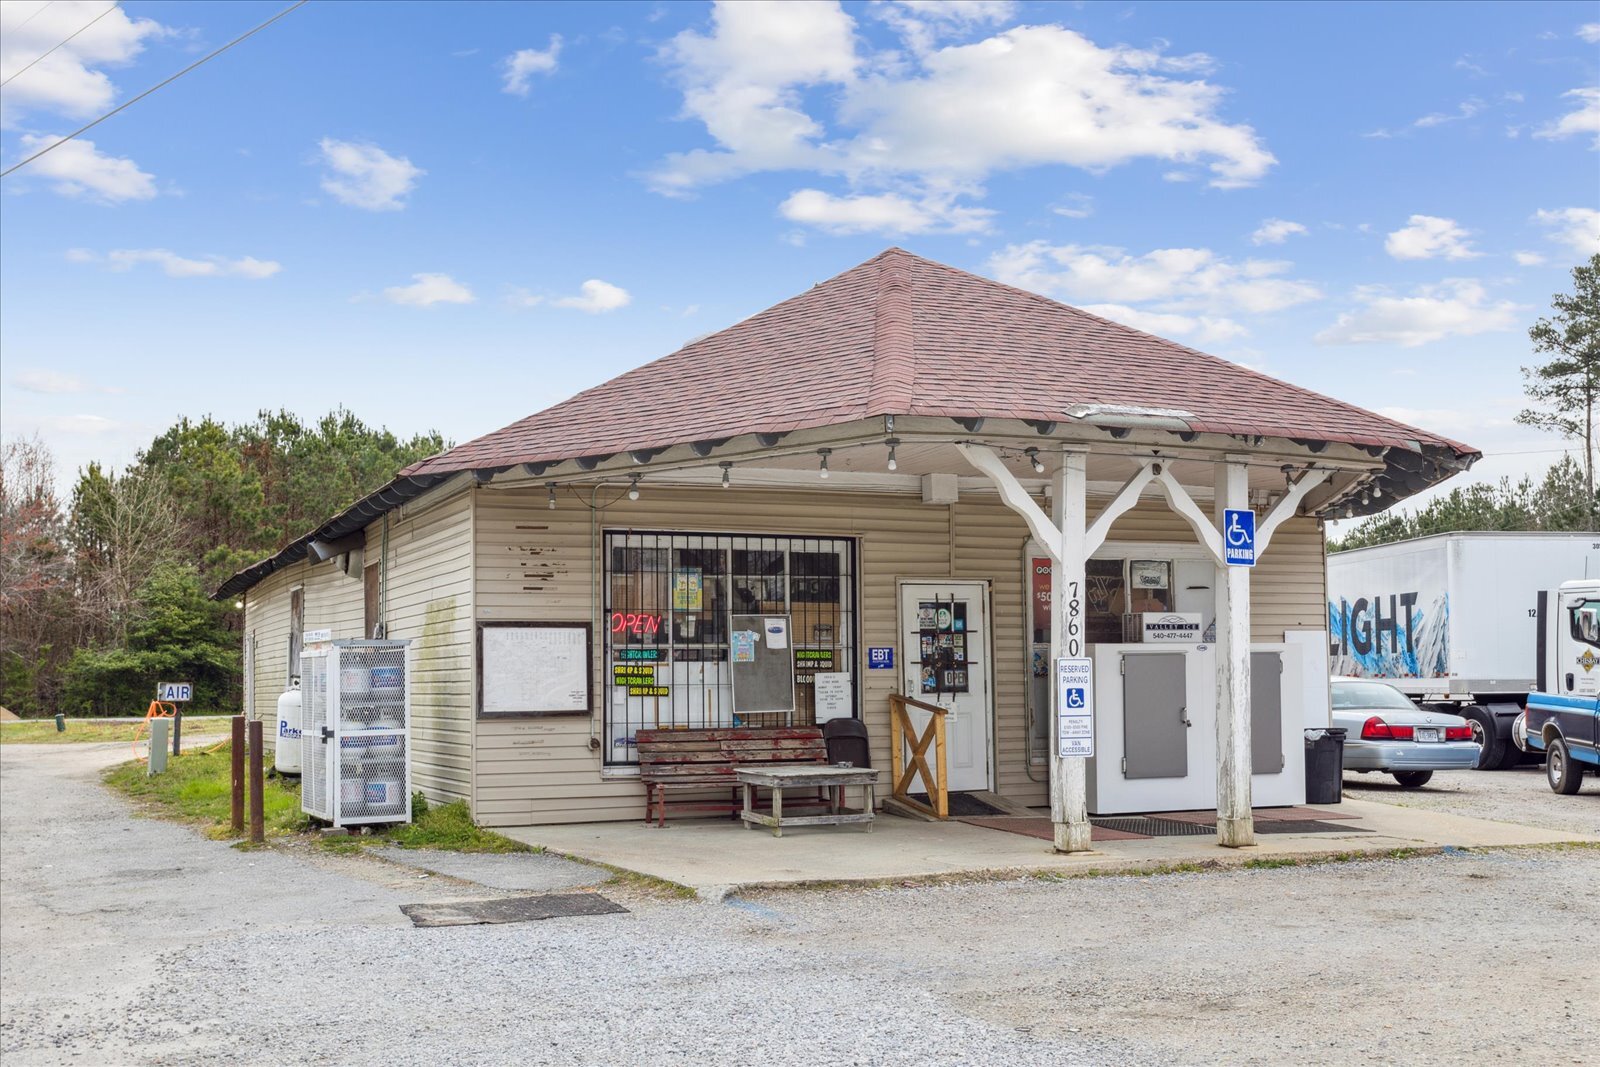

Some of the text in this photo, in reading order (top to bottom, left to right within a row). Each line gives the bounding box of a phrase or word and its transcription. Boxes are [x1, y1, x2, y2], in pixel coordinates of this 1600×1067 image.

[1226, 547, 1254, 560] PARKING
[611, 612, 662, 634] OPEN
[1068, 581, 1080, 657] 7860
[1328, 591, 1419, 657] LIGHT
[872, 648, 890, 660] EBT
[1060, 665, 1090, 673] RESERVED
[1062, 676, 1089, 684] PARKING
[166, 686, 190, 699] AIR
